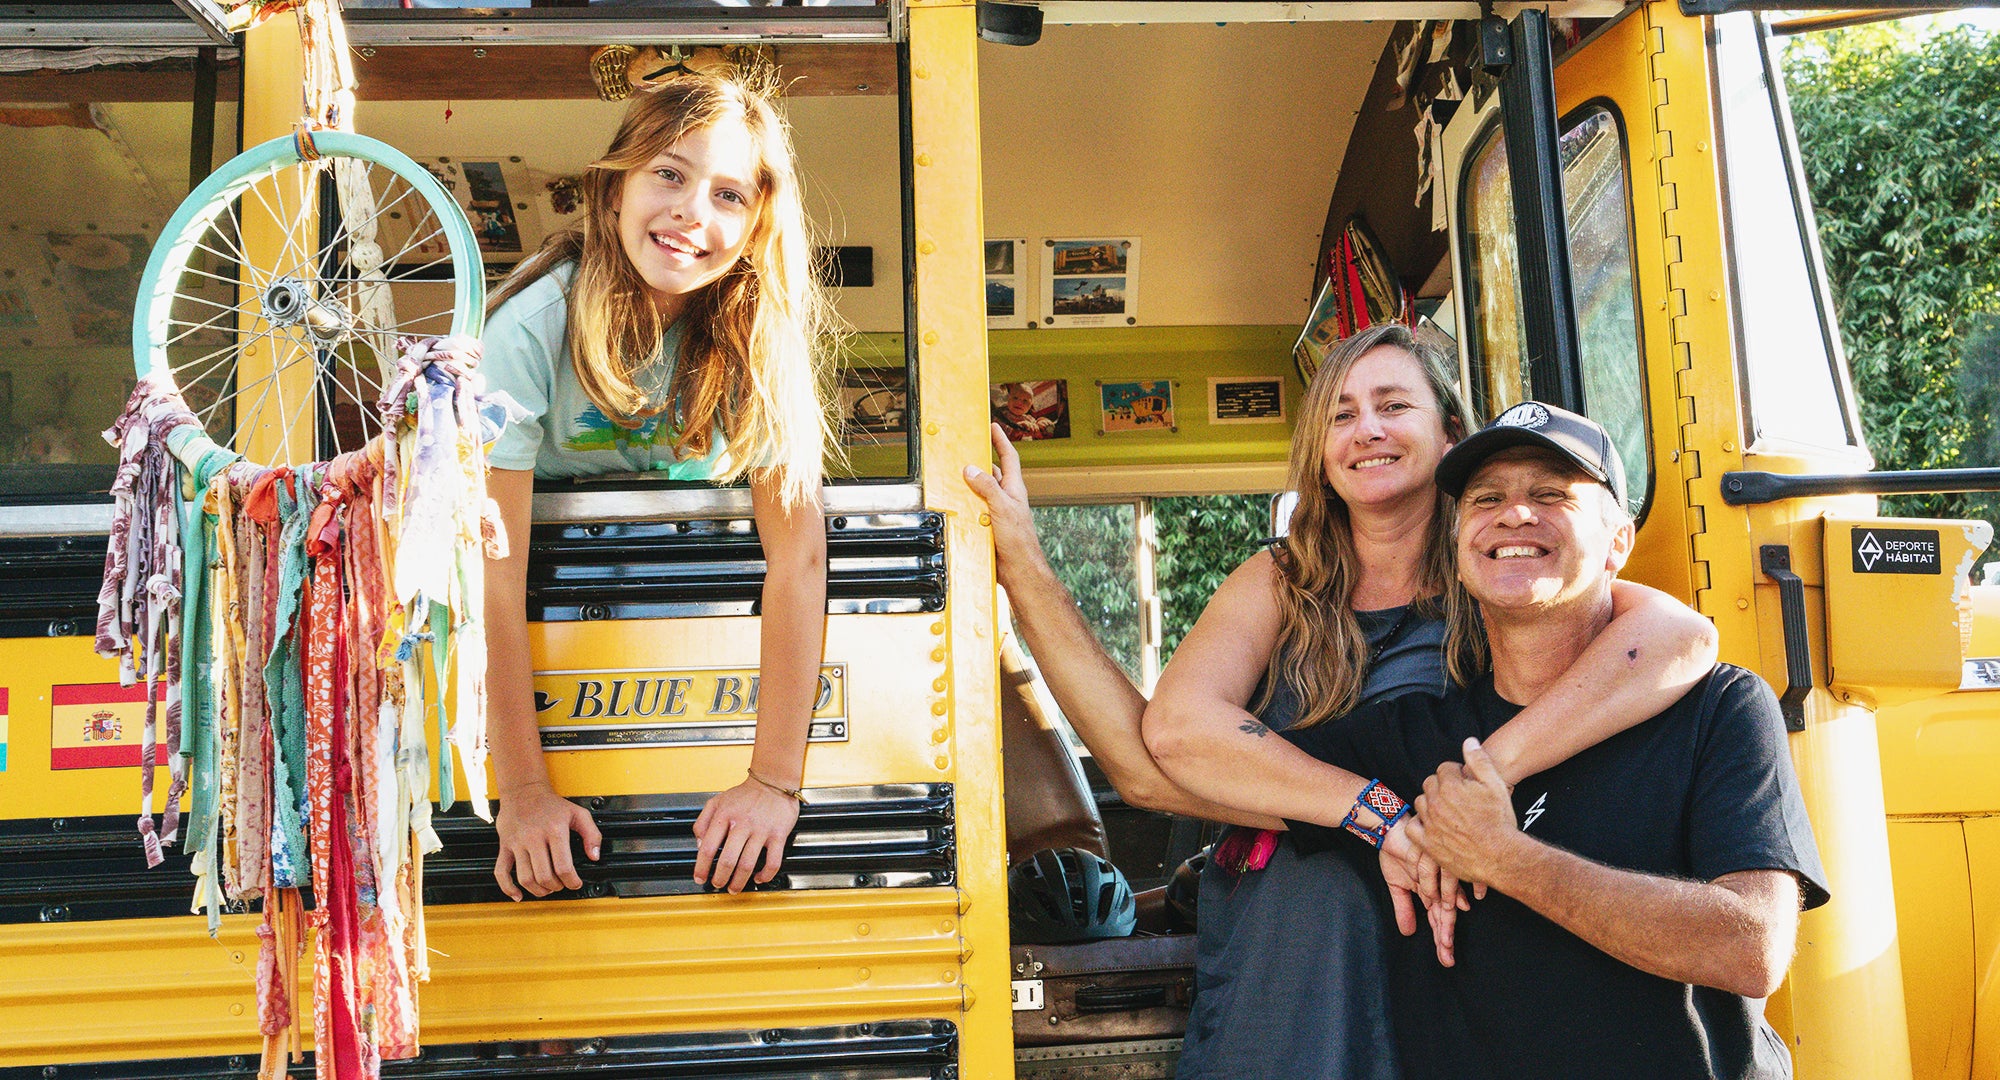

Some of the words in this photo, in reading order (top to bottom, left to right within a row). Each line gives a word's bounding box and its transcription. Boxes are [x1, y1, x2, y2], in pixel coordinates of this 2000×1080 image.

[1885, 540, 1935, 552] DEPORTE
[1885, 551, 1935, 563] HÁBITAT
[568, 677, 693, 719] BLUE
